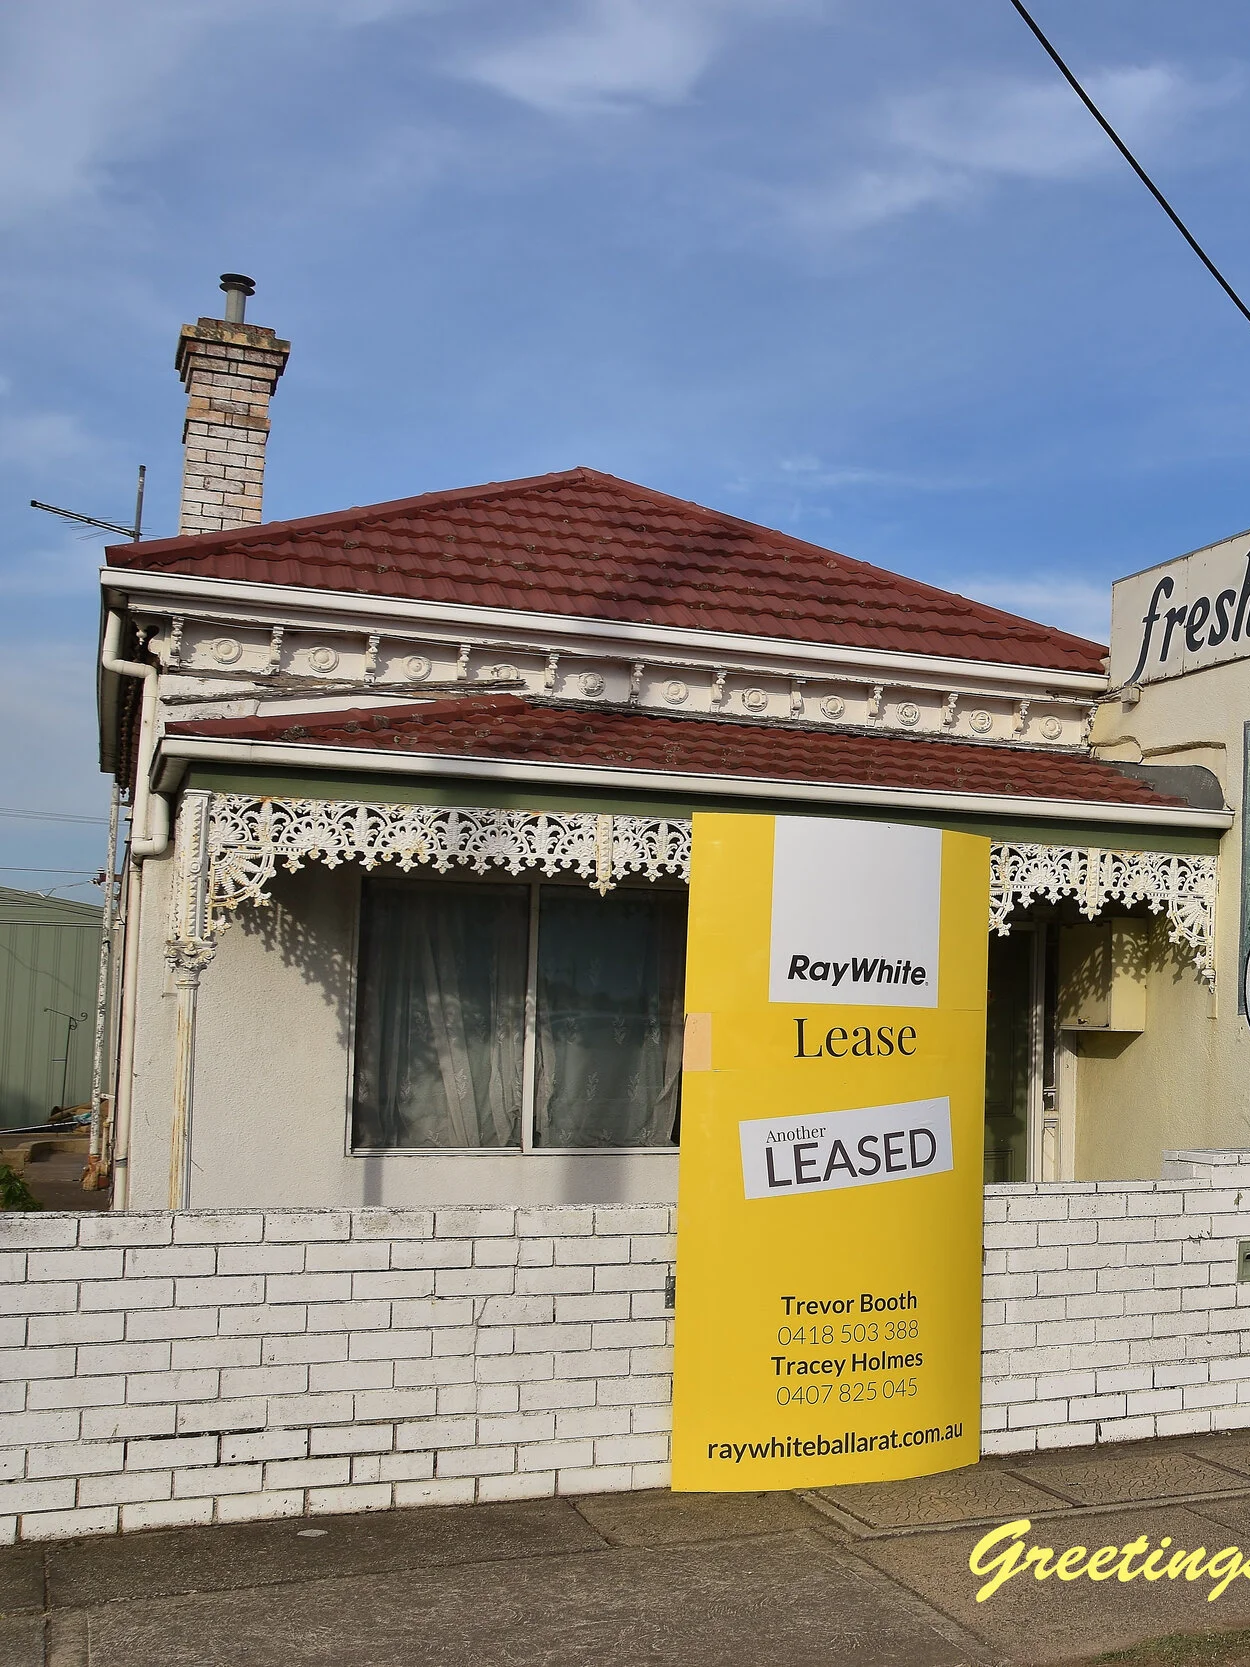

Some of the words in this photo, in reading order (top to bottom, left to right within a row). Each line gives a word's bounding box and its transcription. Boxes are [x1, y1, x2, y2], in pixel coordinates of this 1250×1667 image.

[792, 1017, 917, 1058] Lease
[765, 1125, 827, 1144] Another
[765, 1127, 938, 1188] LEASED
[780, 1295, 855, 1316] Trevor
[859, 1290, 918, 1313] Booth
[777, 1325, 835, 1346] 0418
[840, 1322, 880, 1344] 503
[884, 1319, 919, 1340] 388
[770, 1355, 847, 1378] Tracey
[851, 1350, 924, 1373] Holmes
[776, 1384, 834, 1406] 0407
[838, 1381, 877, 1402] 825
[882, 1377, 919, 1399] 045
[707, 1421, 964, 1464] raywhiteballarat.com.au
